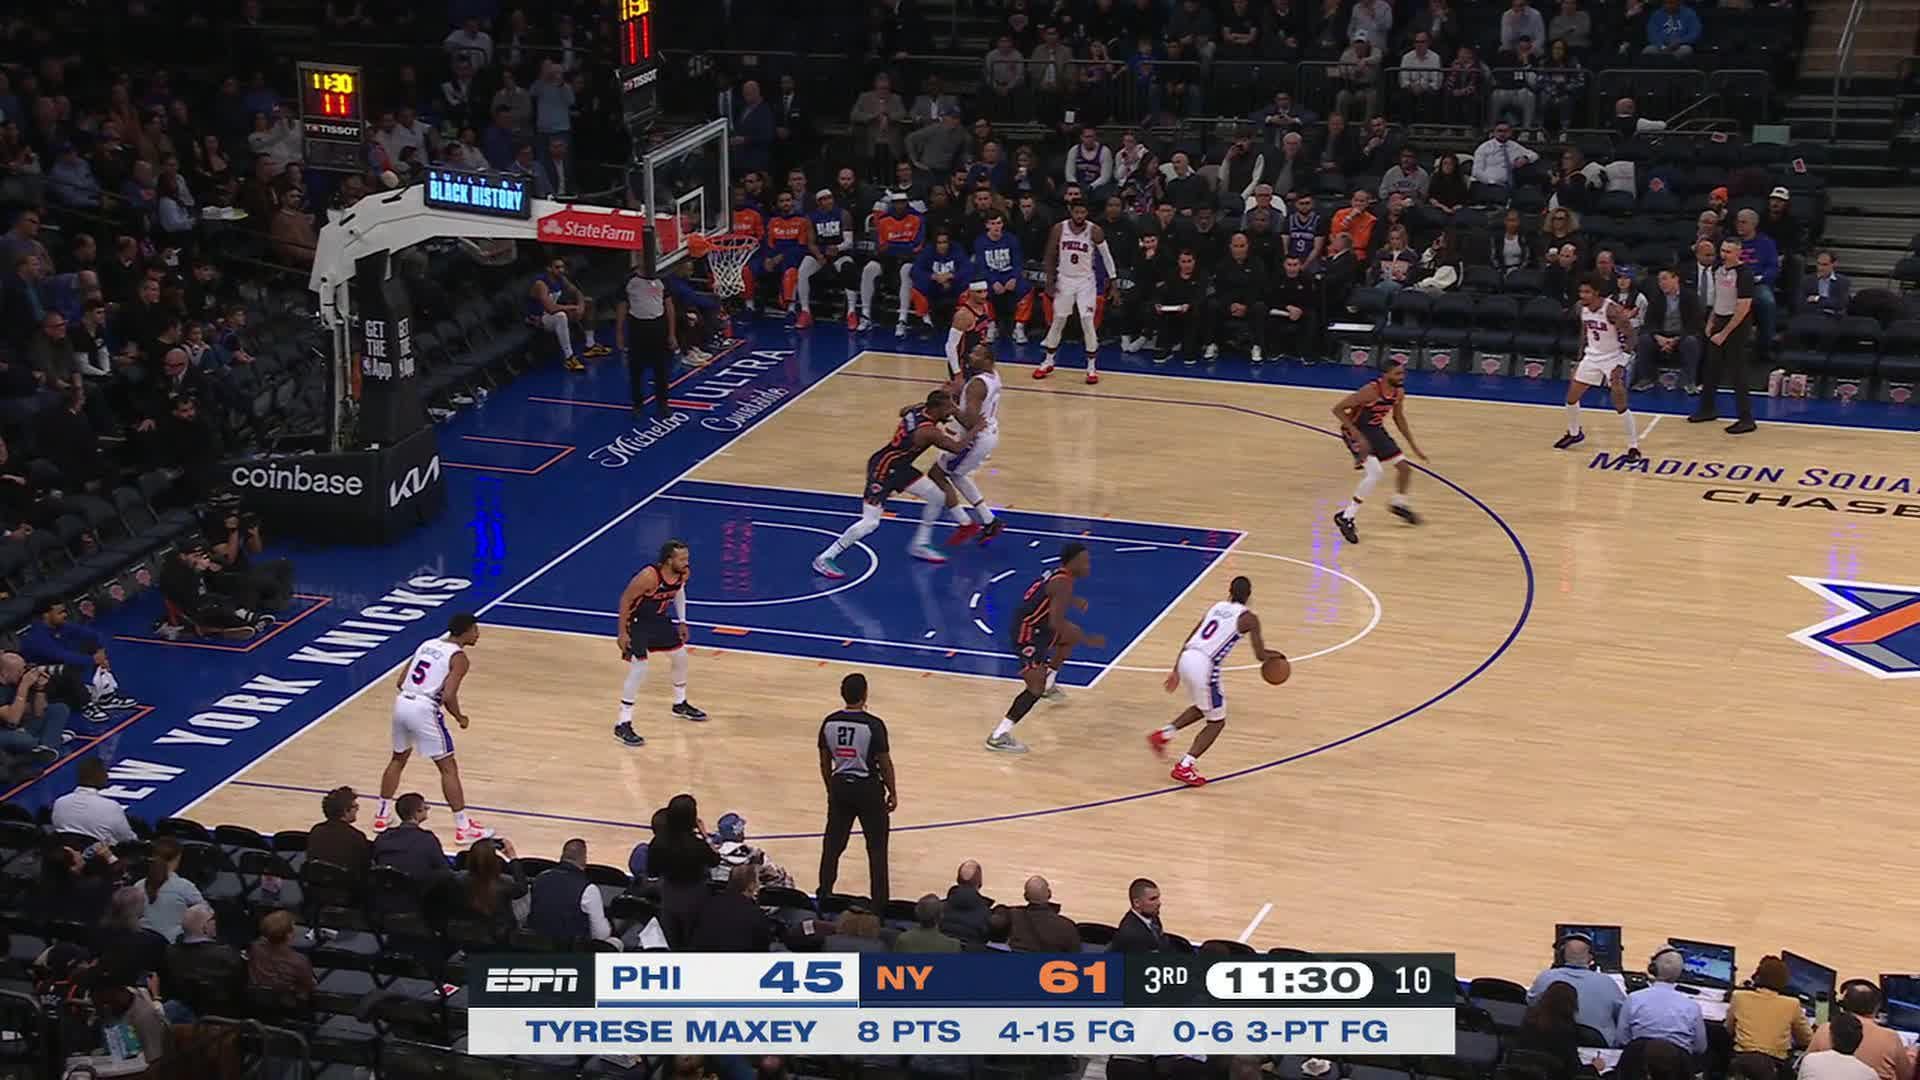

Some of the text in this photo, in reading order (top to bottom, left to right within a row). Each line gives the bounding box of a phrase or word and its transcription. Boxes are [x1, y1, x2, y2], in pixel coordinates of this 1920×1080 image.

[628, 15, 650, 65] 11
[324, 93, 346, 114] 11
[321, 125, 360, 136] TISSOT
[430, 180, 523, 211] BLACK HISTORY
[1296, 239, 1306, 252] 9
[1071, 253, 1079, 264] 8
[366, 320, 384, 337] GET
[366, 339, 386, 357] THE
[372, 358, 392, 380] App
[684, 350, 795, 399] ULTRA
[232, 463, 363, 495] coinbase
[1588, 452, 1920, 494] MADISON SQUA
[1702, 489, 1920, 518] CHASE
[1202, 620, 1218, 640] 0
[412, 660, 431, 685] 5
[98, 575, 472, 809] EW YORK KNICKS
[837, 726, 856, 746] 27
